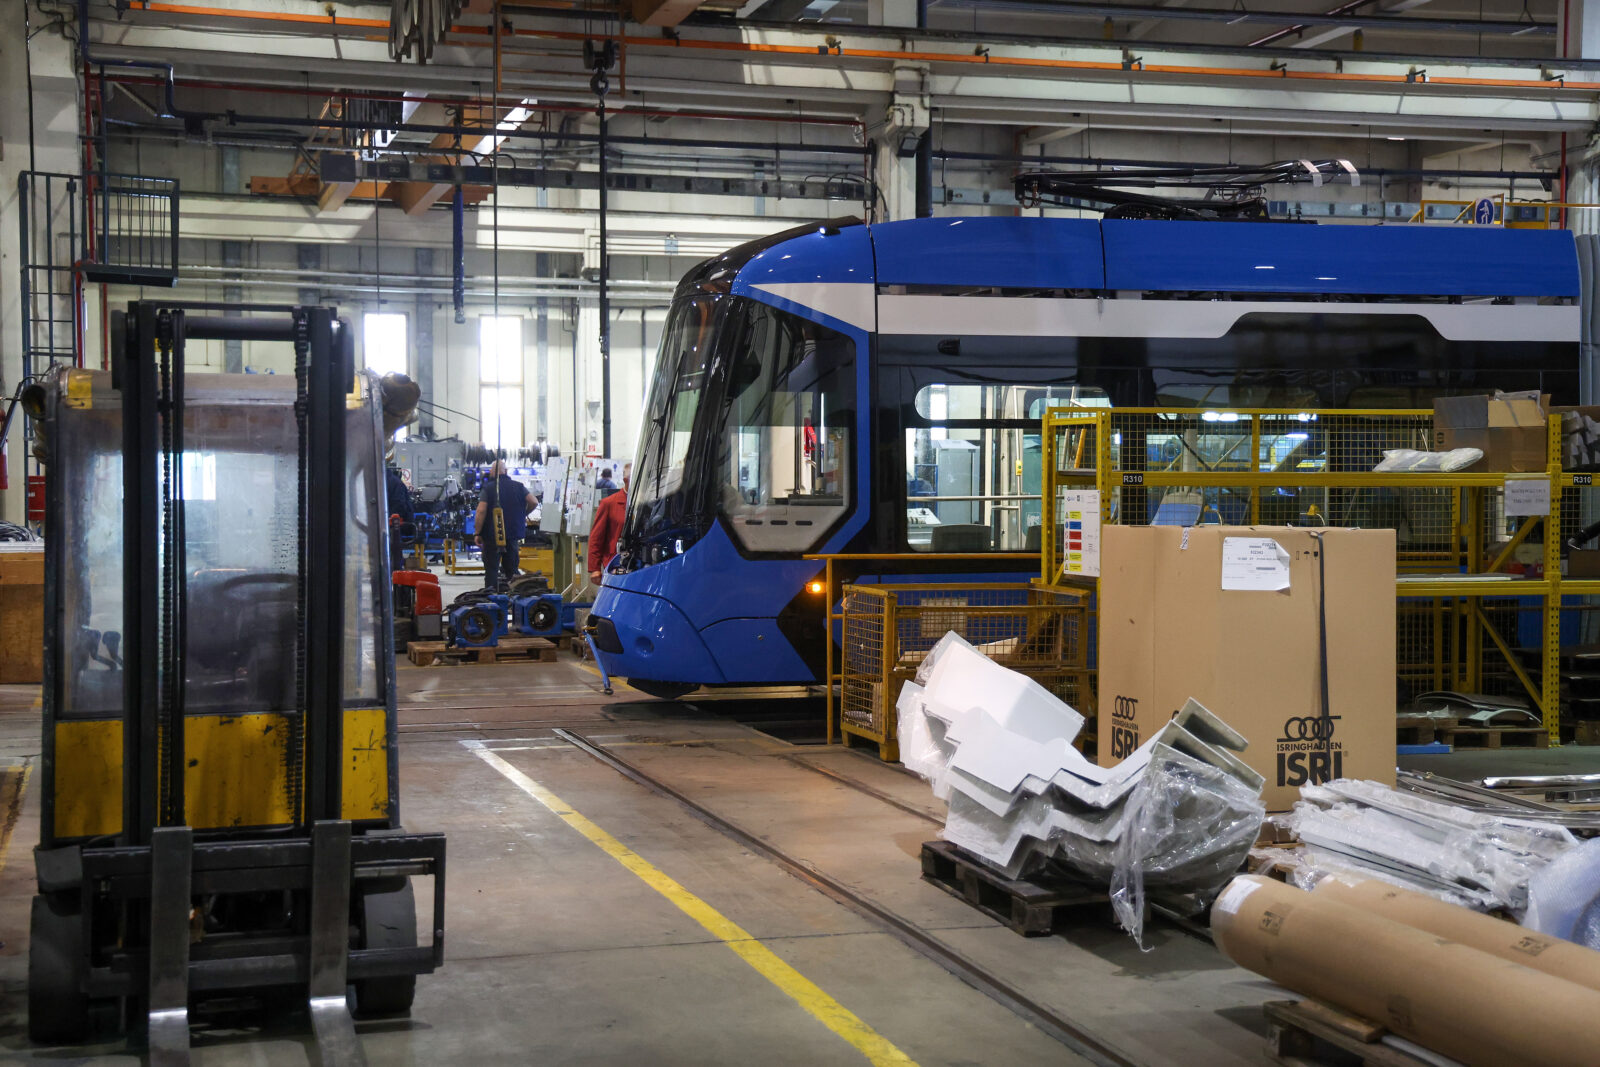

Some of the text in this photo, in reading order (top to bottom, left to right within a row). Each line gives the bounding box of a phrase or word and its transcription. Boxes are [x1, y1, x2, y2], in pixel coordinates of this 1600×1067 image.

[1123, 475, 1143, 483] R310
[1573, 476, 1592, 484] R310
[1112, 726, 1138, 760] ISRI
[1277, 742, 1342, 751] ISRINGHAUEN
[1277, 751, 1342, 787] ISRI
